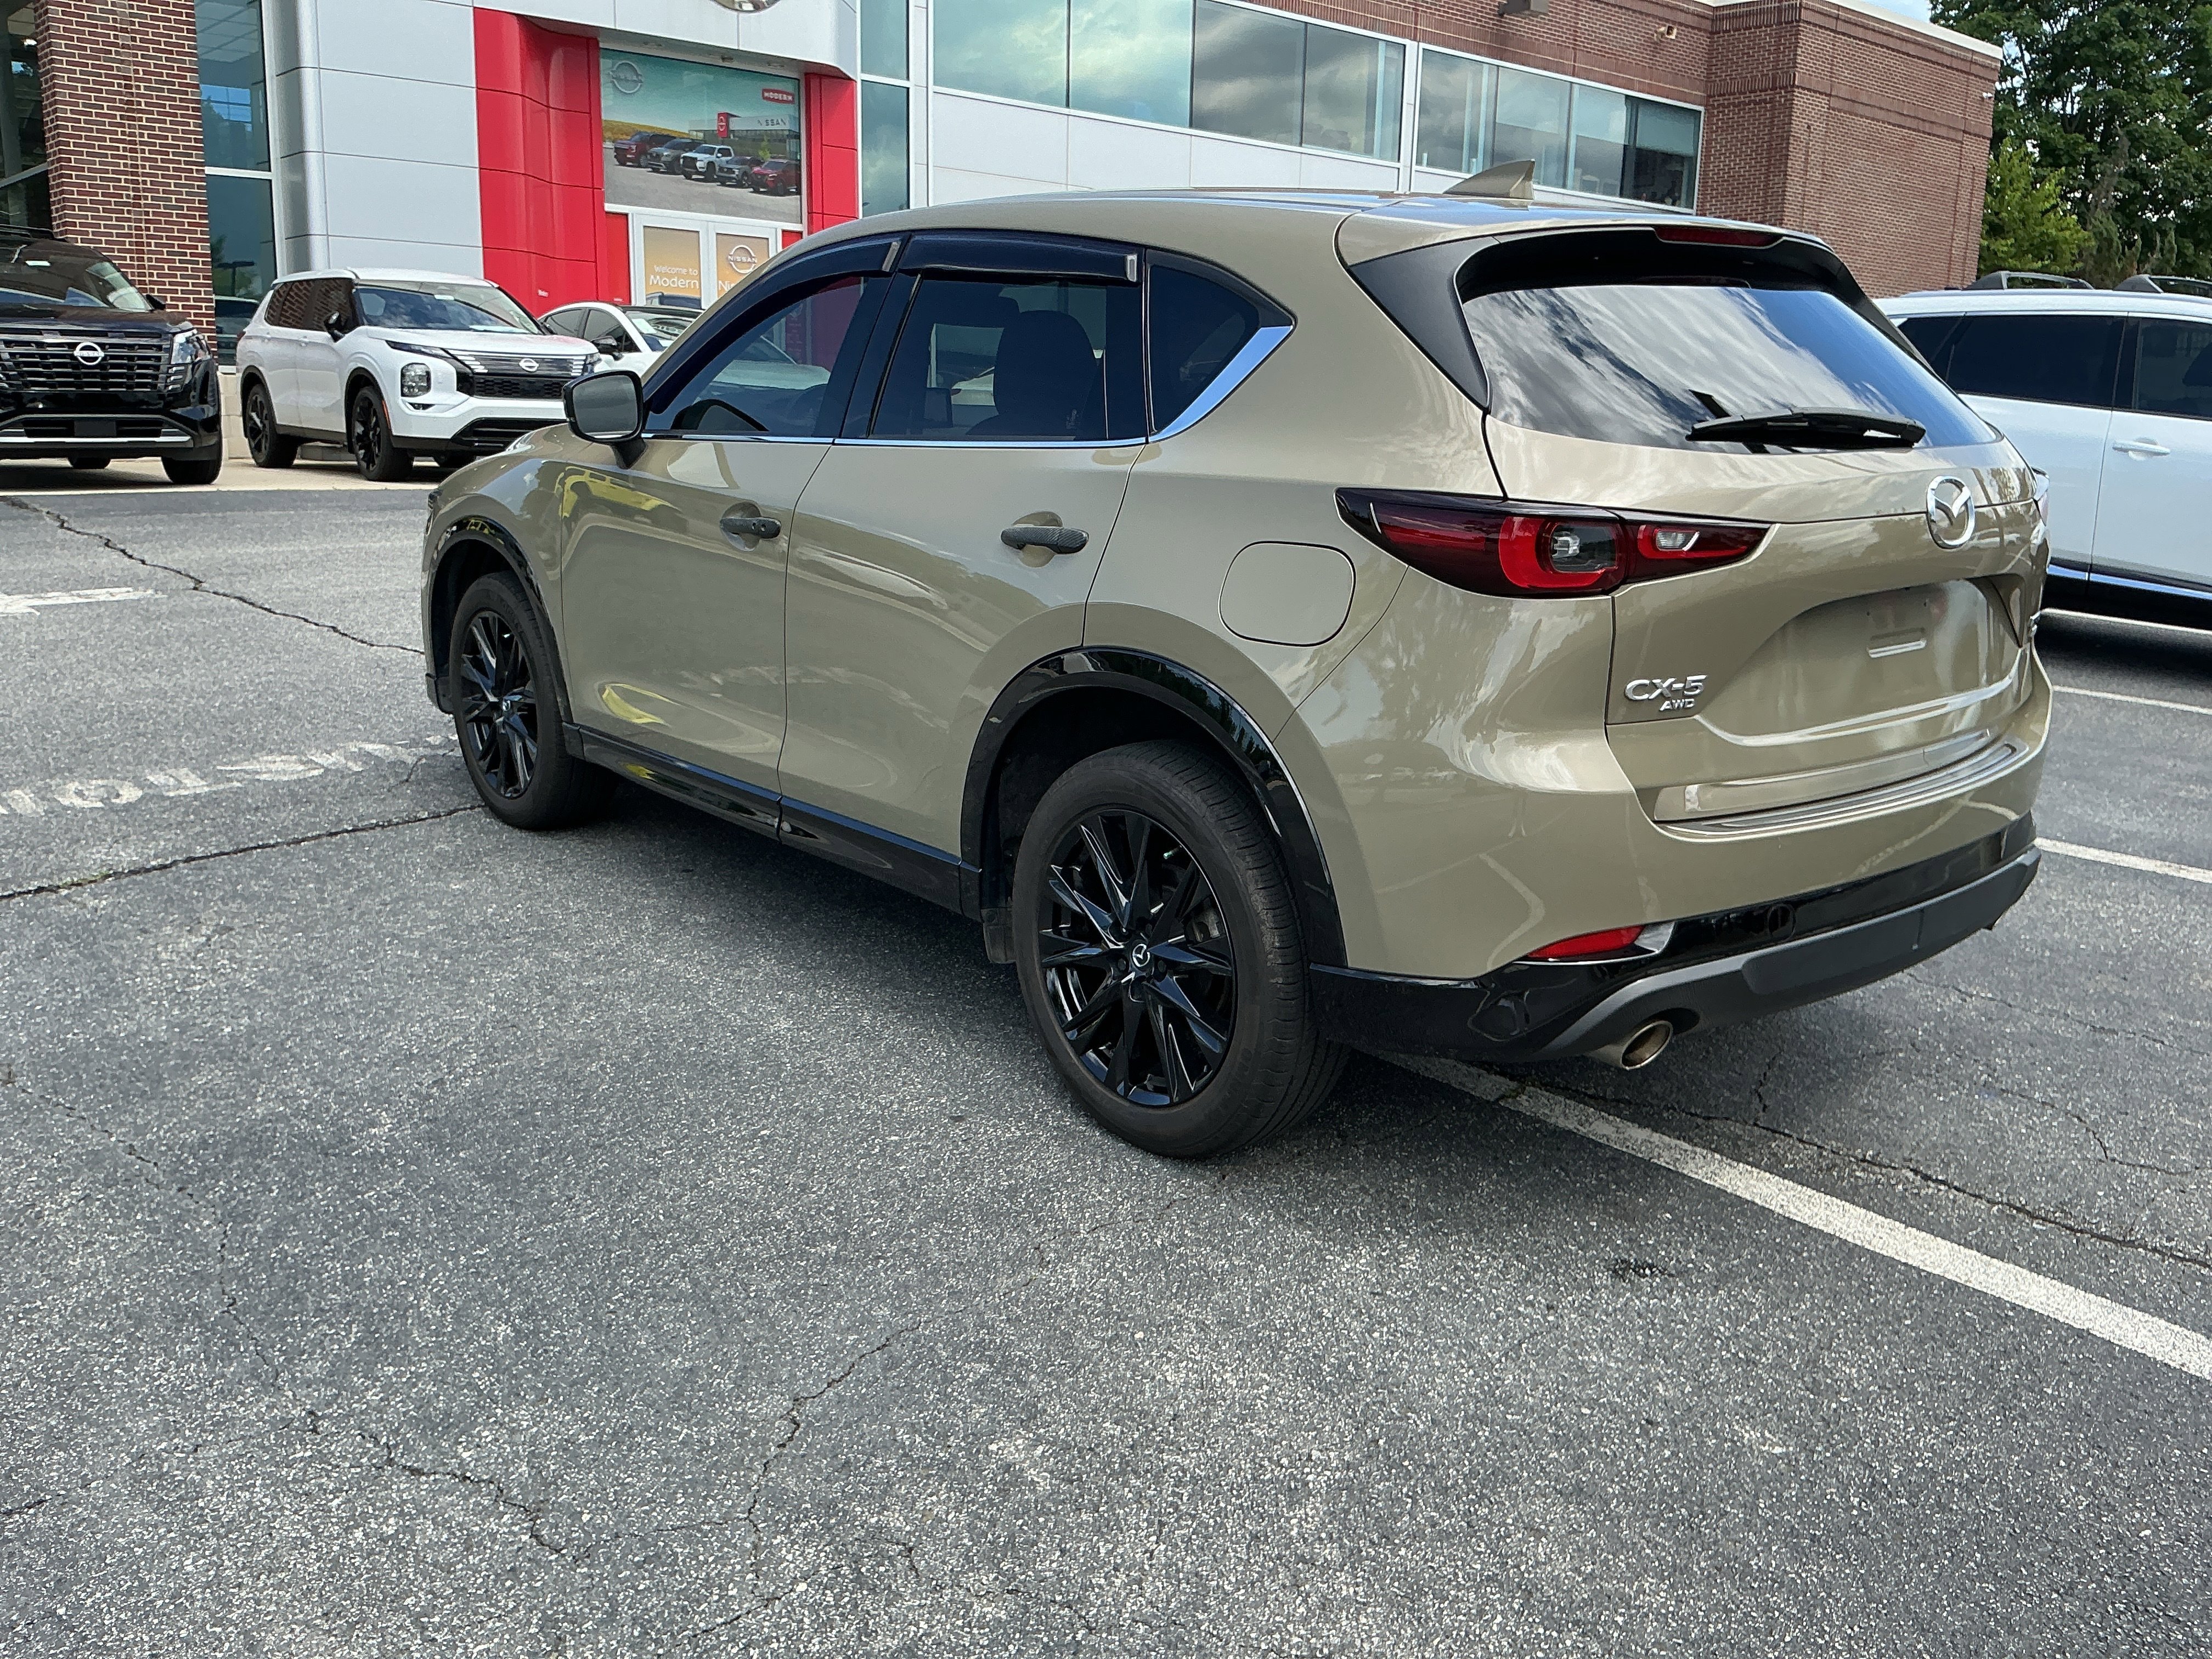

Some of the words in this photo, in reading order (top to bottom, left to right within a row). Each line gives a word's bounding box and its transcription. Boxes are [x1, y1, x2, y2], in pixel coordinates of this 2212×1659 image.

[728, 255, 757, 263] NISSAN
[653, 264, 687, 275] Welcome
[689, 267, 698, 276] to
[650, 274, 699, 289] Modern
[1624, 674, 1707, 701] CX-5
[1658, 698, 1695, 712] AWD
